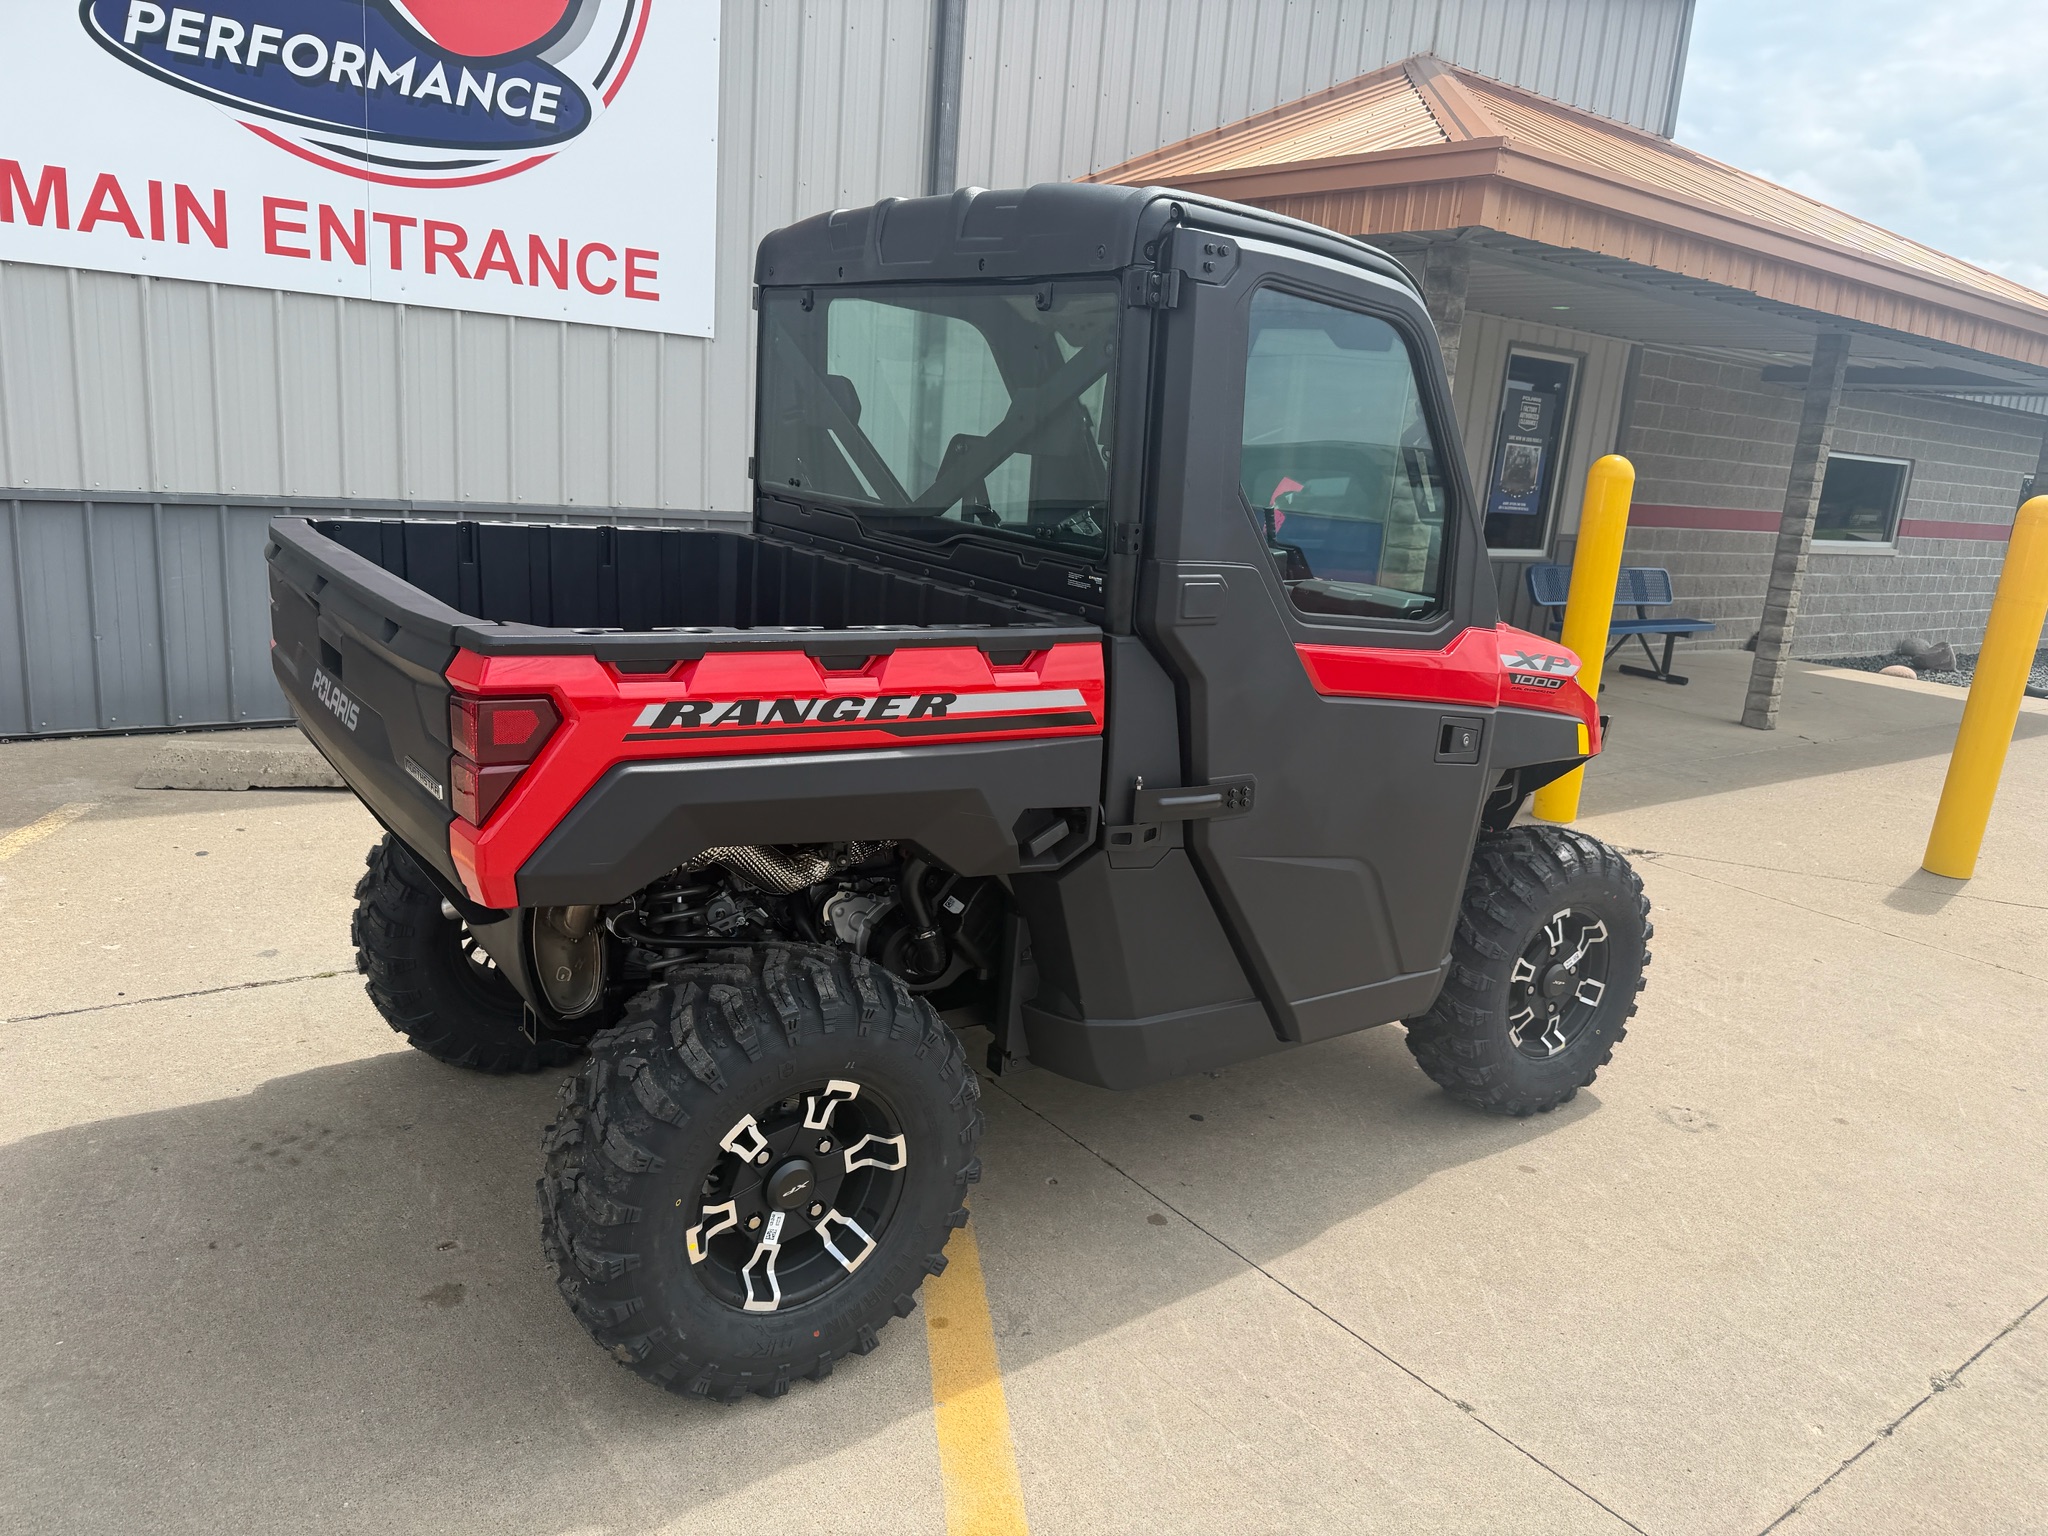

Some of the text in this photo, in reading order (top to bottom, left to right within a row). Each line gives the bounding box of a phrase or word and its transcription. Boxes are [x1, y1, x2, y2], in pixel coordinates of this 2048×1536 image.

[124, 2, 562, 124] PERFORMANCE
[0, 159, 660, 301] MAIN ENTRANCE
[1507, 650, 1572, 672] XP
[1514, 674, 1561, 689] 1000
[311, 667, 360, 732] POLARIS
[649, 692, 957, 729] RANGER
